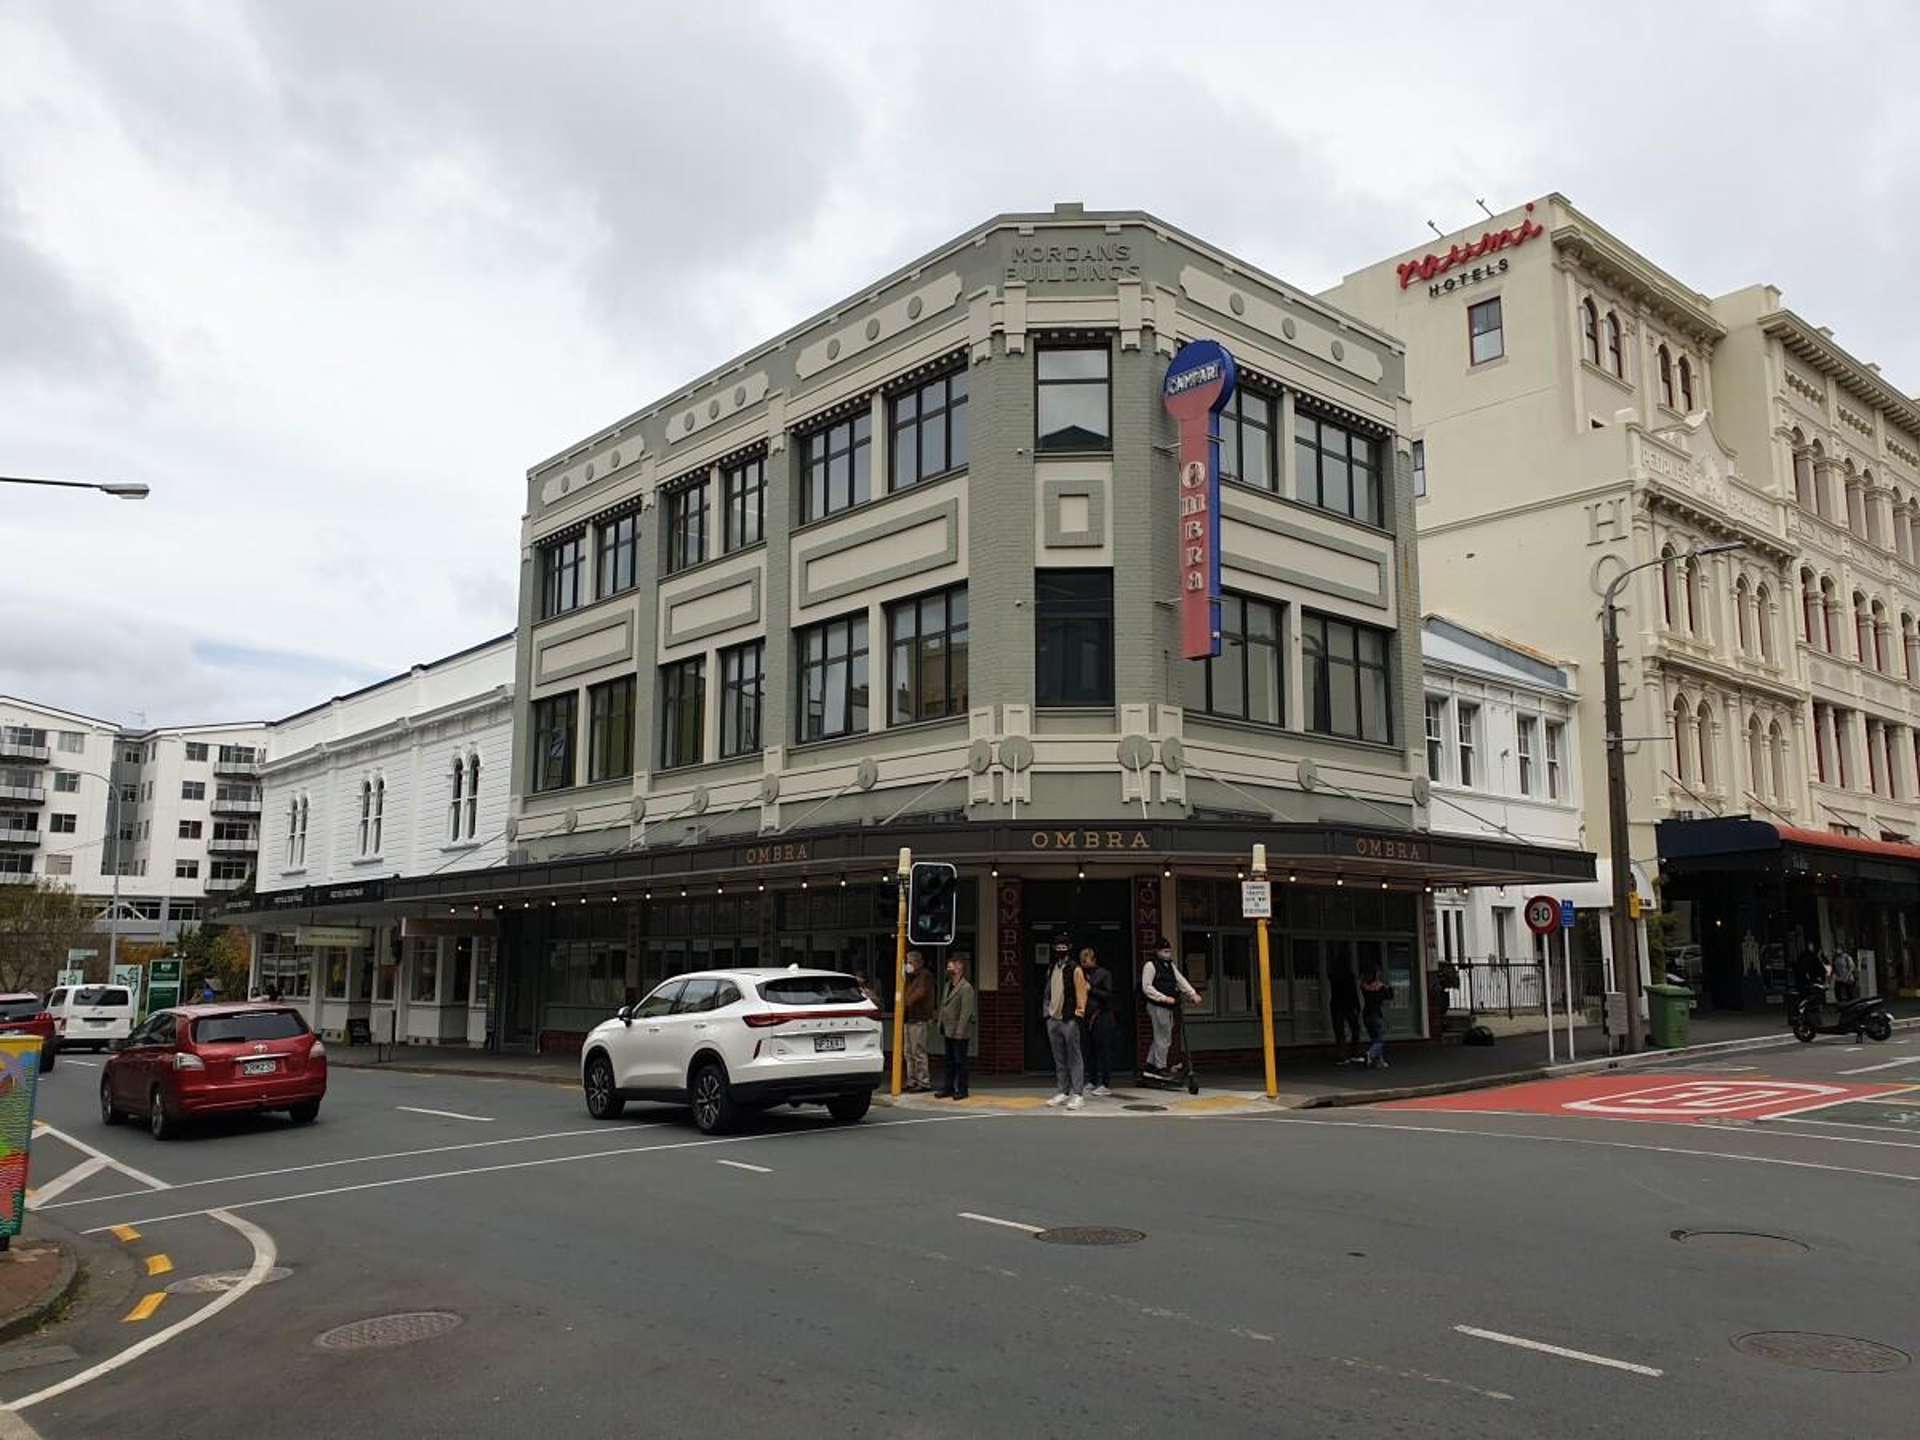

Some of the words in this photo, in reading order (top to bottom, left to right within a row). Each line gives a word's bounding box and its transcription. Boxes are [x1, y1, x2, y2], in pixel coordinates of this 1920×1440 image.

[1429, 258, 1509, 298] HOTELS
[1032, 832, 1150, 849] OMBRA
[1356, 838, 1421, 861] OMBRA
[746, 844, 808, 864] OMBRA
[1532, 907, 1550, 921] 30
[1001, 887, 1021, 986] OMBRA
